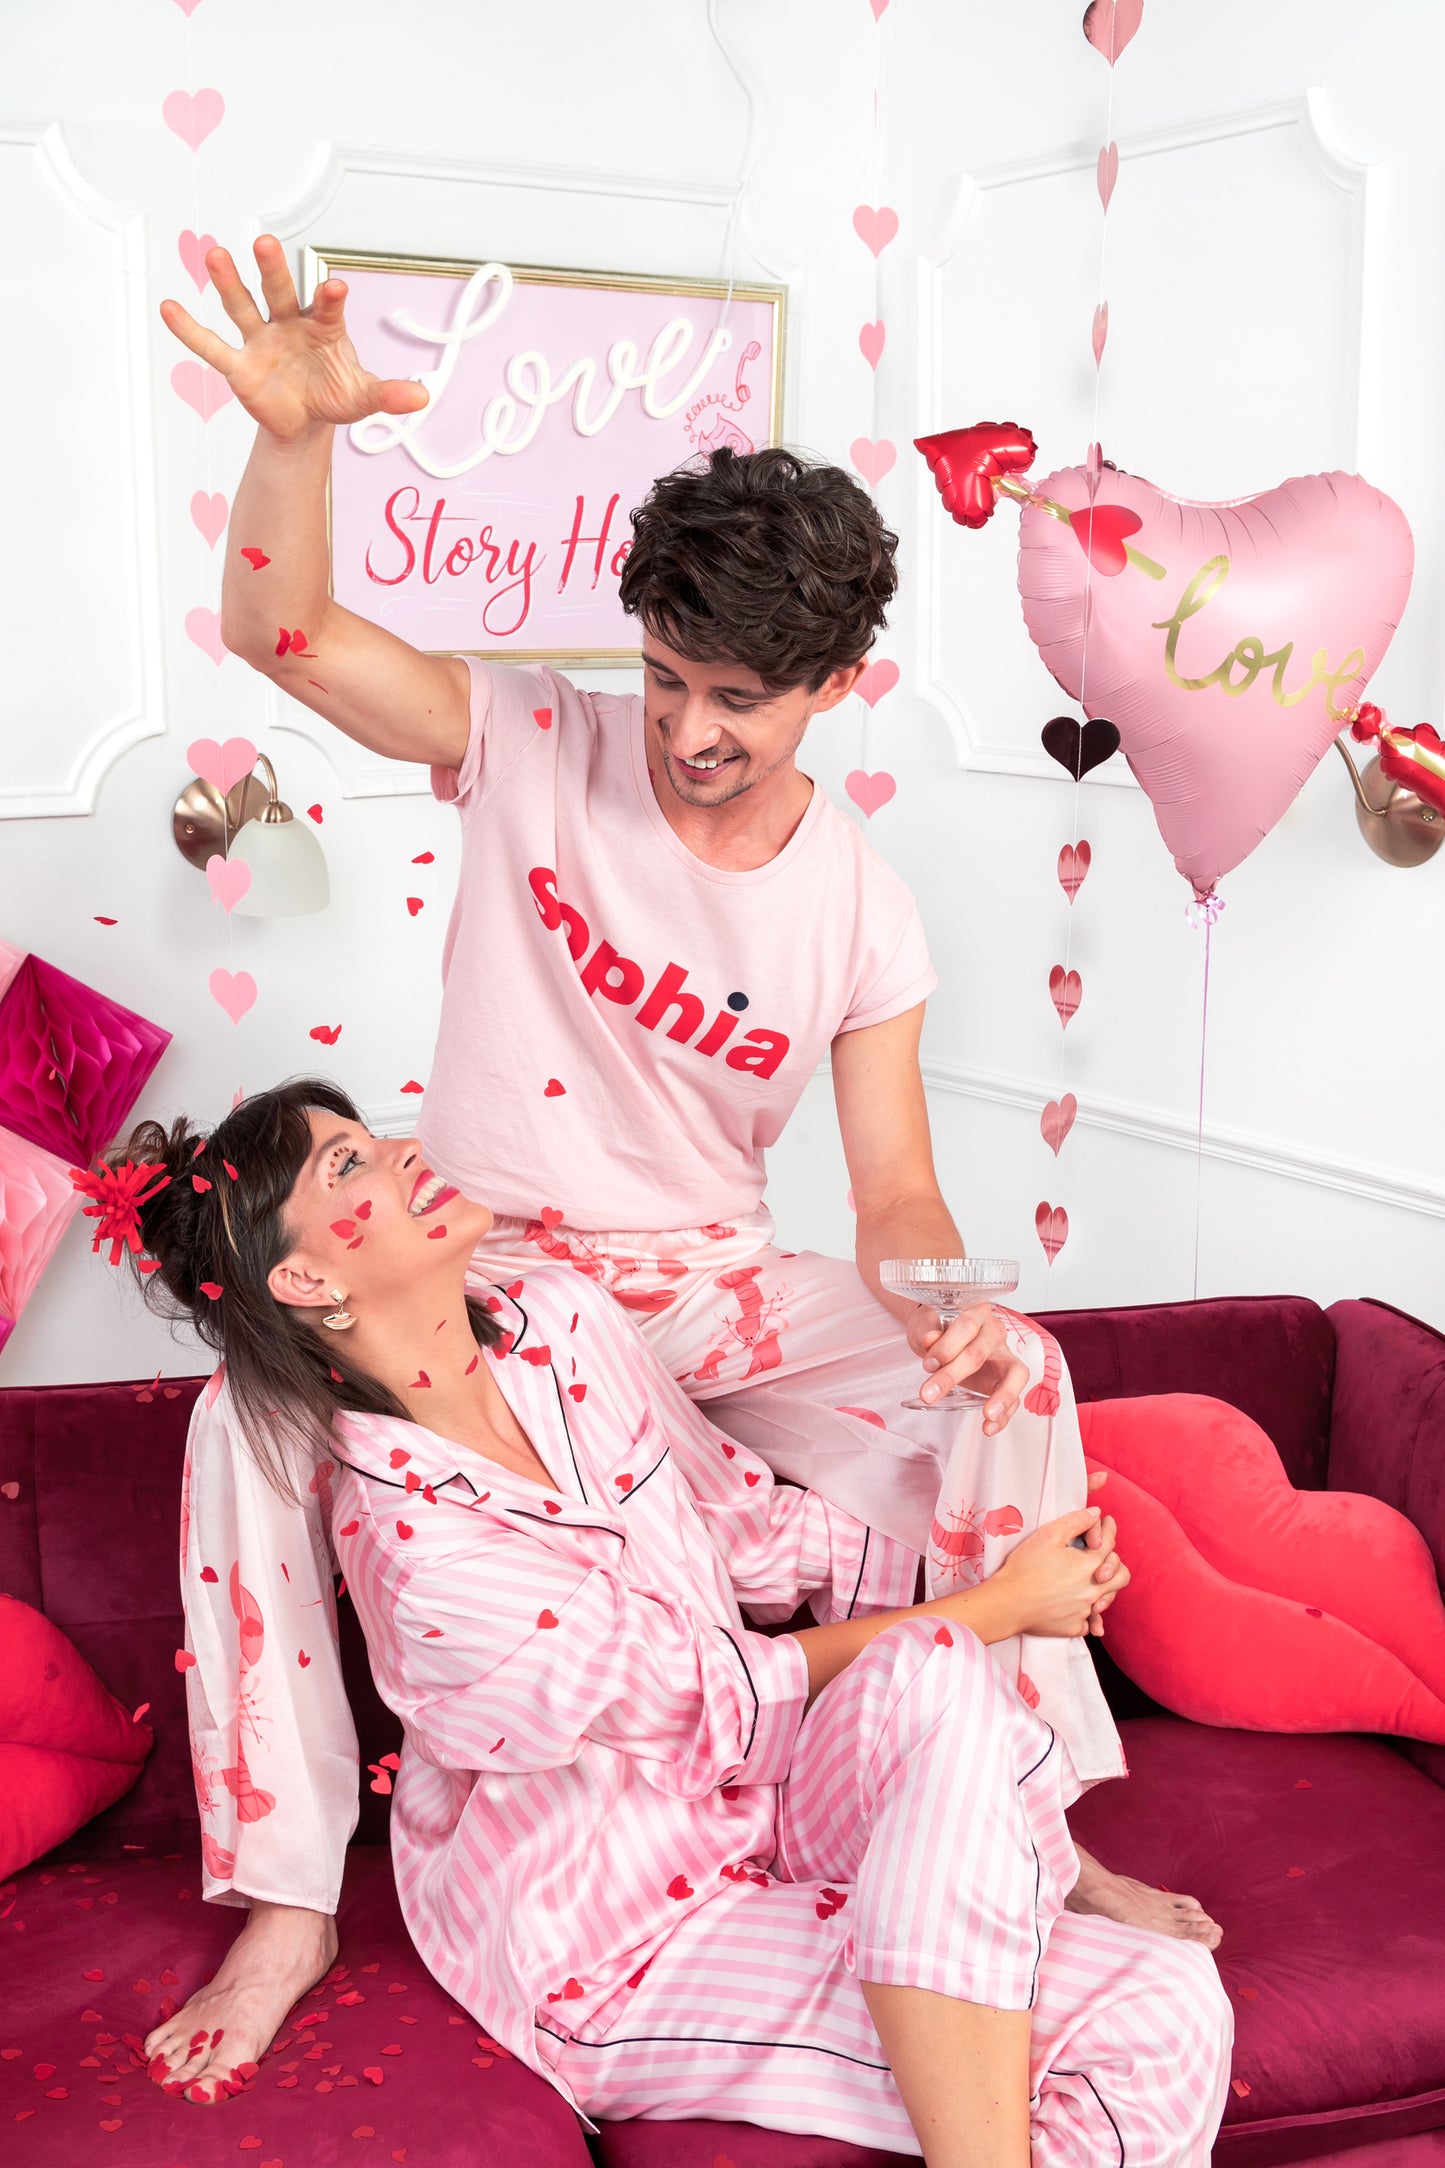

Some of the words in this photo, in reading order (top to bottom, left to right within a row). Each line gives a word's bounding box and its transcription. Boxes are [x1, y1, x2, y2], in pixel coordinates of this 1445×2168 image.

[349, 262, 729, 479] Love
[365, 486, 547, 636] Story
[1152, 554, 1366, 722] love
